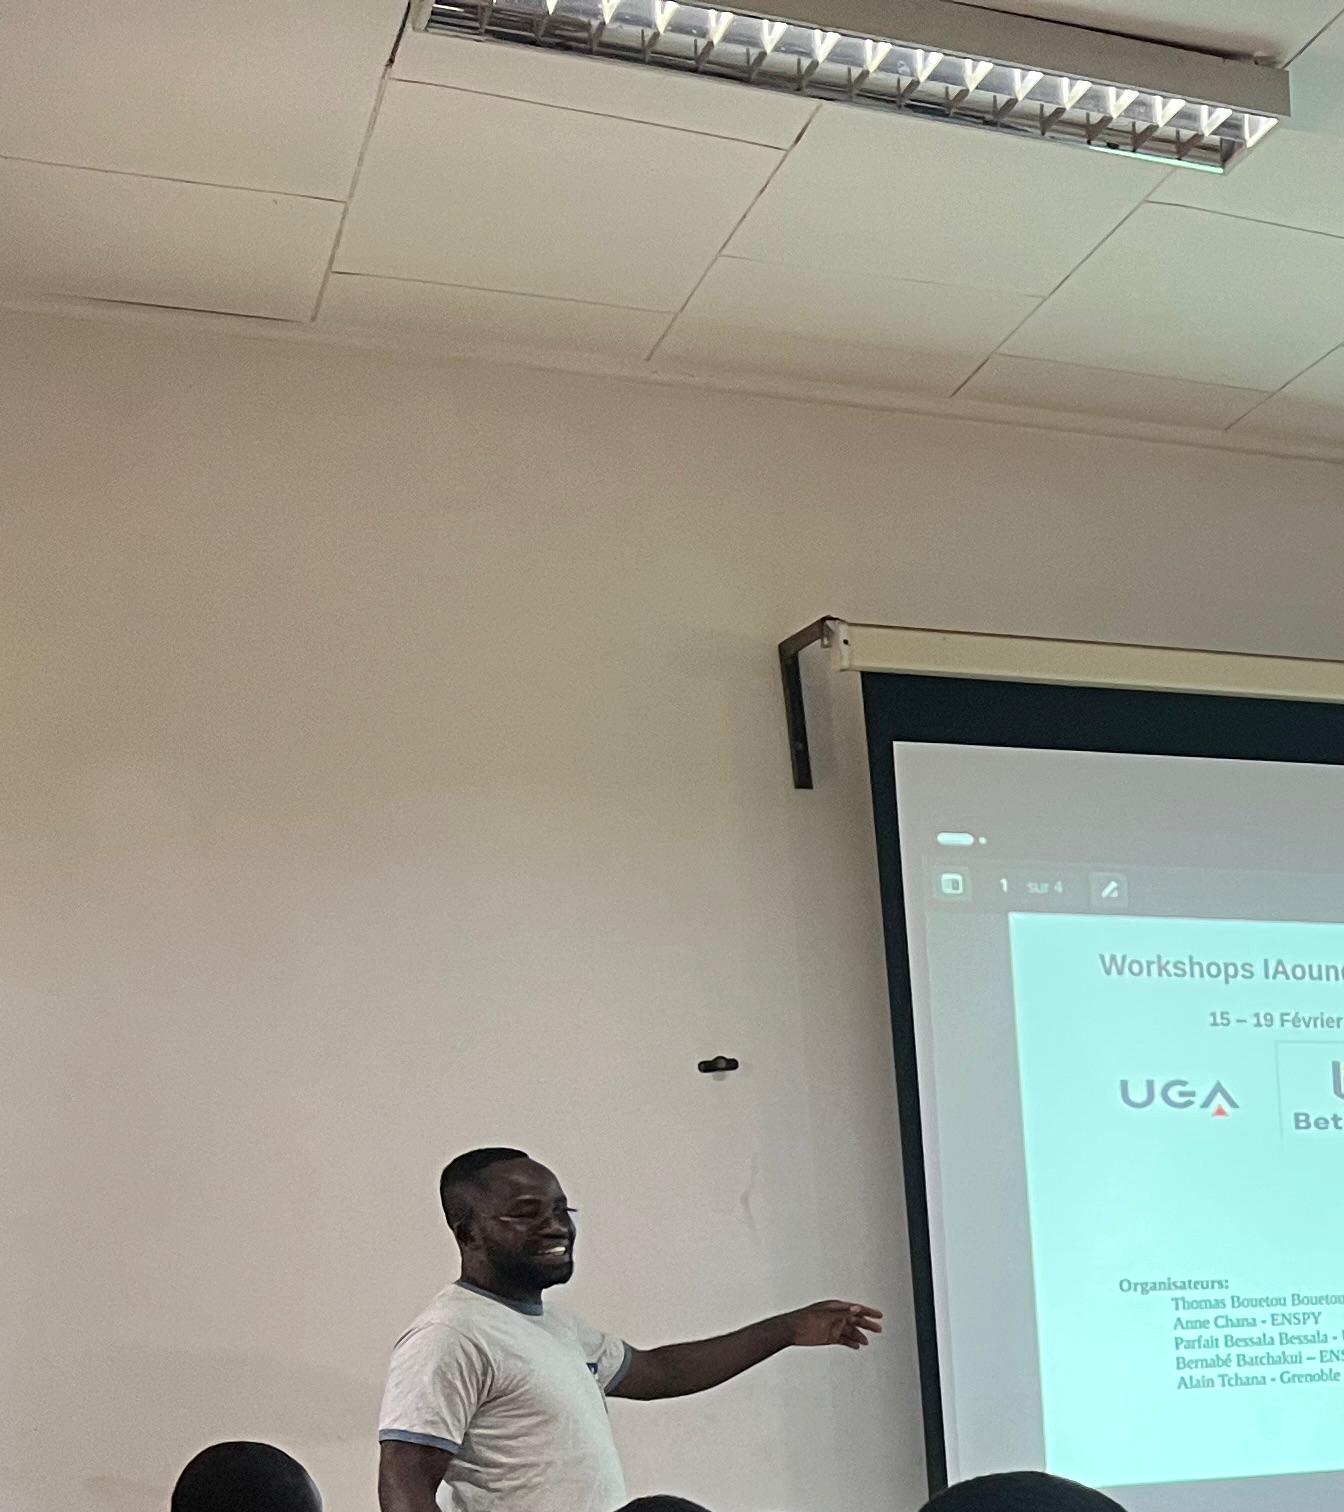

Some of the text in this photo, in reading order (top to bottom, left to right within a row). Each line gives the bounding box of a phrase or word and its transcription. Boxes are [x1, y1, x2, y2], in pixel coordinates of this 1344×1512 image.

[999, 878, 1008, 893] 1
[1053, 880, 1063, 894] 4
[1098, 953, 1255, 985] Workshops
[1208, 1011, 1231, 1028] 15
[1252, 1011, 1274, 1028] 19
[1279, 1010, 1344, 1030] Février
[1119, 1078, 1240, 1116] UGA
[1118, 1277, 1230, 1295] Organisateurs:
[1171, 1296, 1226, 1311] Thomas
[1230, 1294, 1287, 1309] Bouetou
[1173, 1317, 1210, 1331] Anne
[1214, 1314, 1257, 1329] Chana
[1270, 1311, 1322, 1327] ENSPY
[1174, 1334, 1220, 1351] Parfait
[1224, 1332, 1275, 1348] Bessala
[1279, 1330, 1328, 1346] Bessala
[1176, 1353, 1232, 1370] Bernabé
[1177, 1375, 1215, 1390] Alain
[1218, 1372, 1267, 1388] Tchana
[1279, 1369, 1341, 1385] Grenoble
